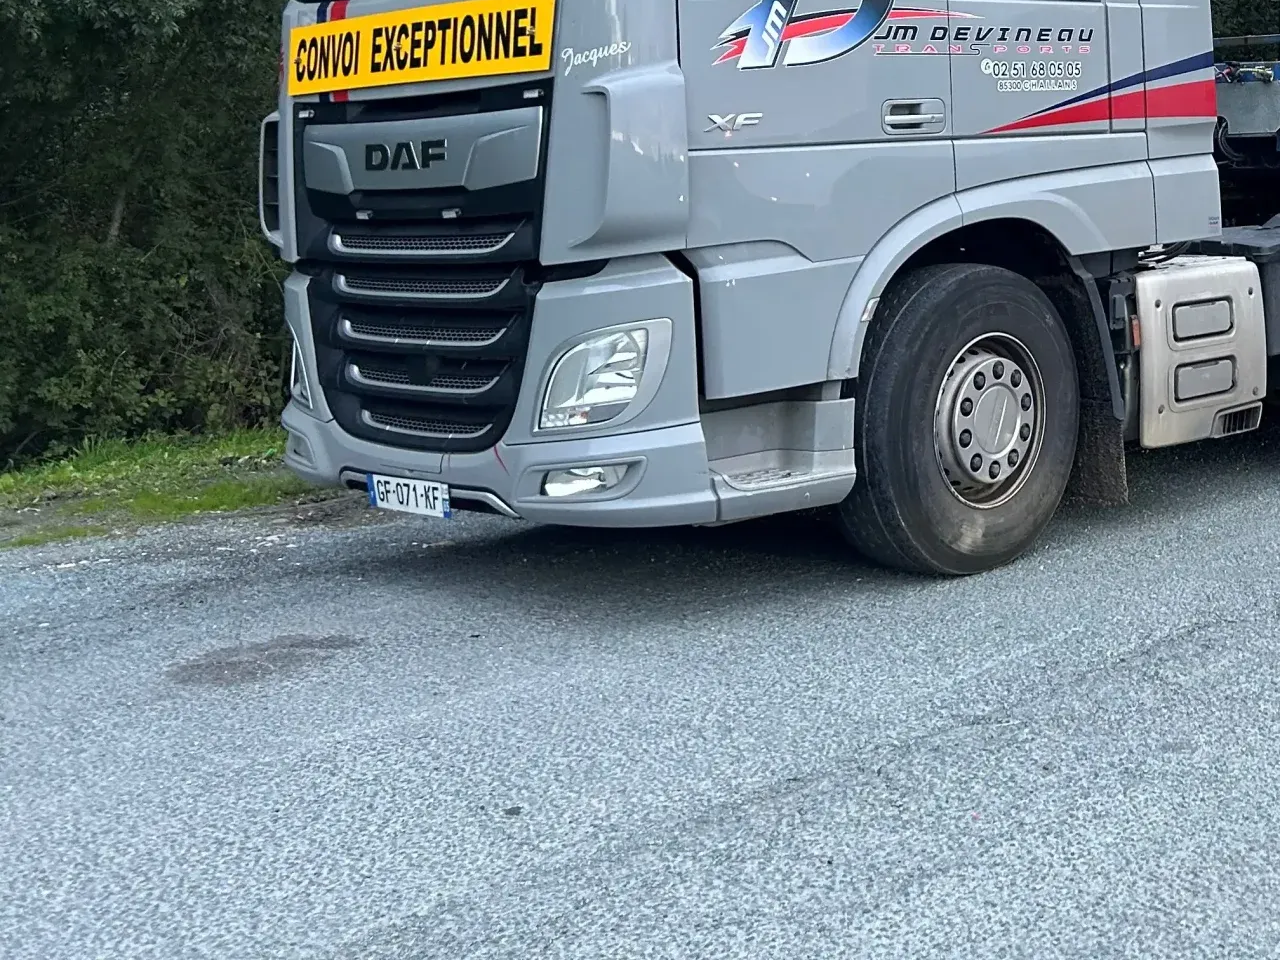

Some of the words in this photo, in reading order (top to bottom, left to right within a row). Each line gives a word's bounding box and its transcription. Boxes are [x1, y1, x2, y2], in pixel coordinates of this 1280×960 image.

[873, 25, 919, 40] JM
[930, 26, 1094, 42] DEVINEAU
[296, 30, 361, 83] CONVOI
[370, 6, 543, 74] EXCEPTIONNEL
[872, 43, 1092, 56] TRANSPORTS
[561, 41, 632, 77] Jacques
[992, 62, 1009, 77] 02
[1012, 62, 1026, 77] 51
[1031, 62, 1046, 77] 68
[1049, 62, 1064, 77] 05
[1066, 62, 1081, 77] 05
[998, 80, 1022, 91] 85300
[1023, 80, 1077, 91] CHALLANS
[703, 112, 763, 132] XF
[365, 139, 447, 171] DAF
[376, 479, 439, 510] GF-071-KF
